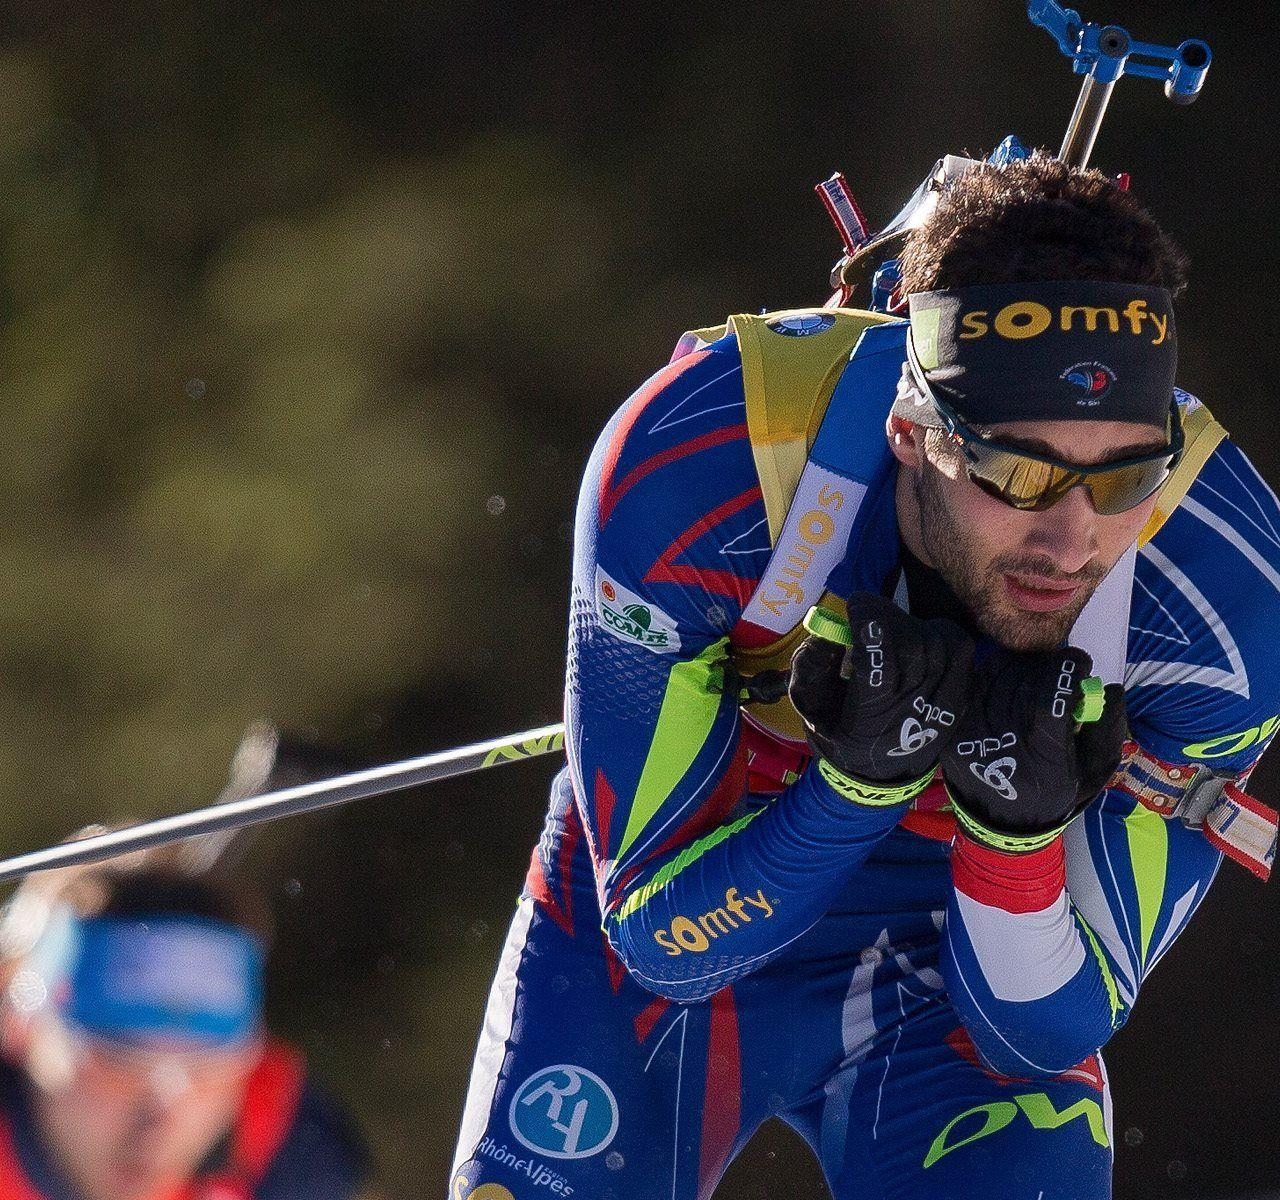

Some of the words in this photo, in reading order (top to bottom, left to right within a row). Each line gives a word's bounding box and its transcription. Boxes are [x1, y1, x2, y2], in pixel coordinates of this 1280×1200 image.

[959, 299, 1168, 346] somfy
[759, 483, 844, 617] somfy
[654, 887, 774, 956] somfy
